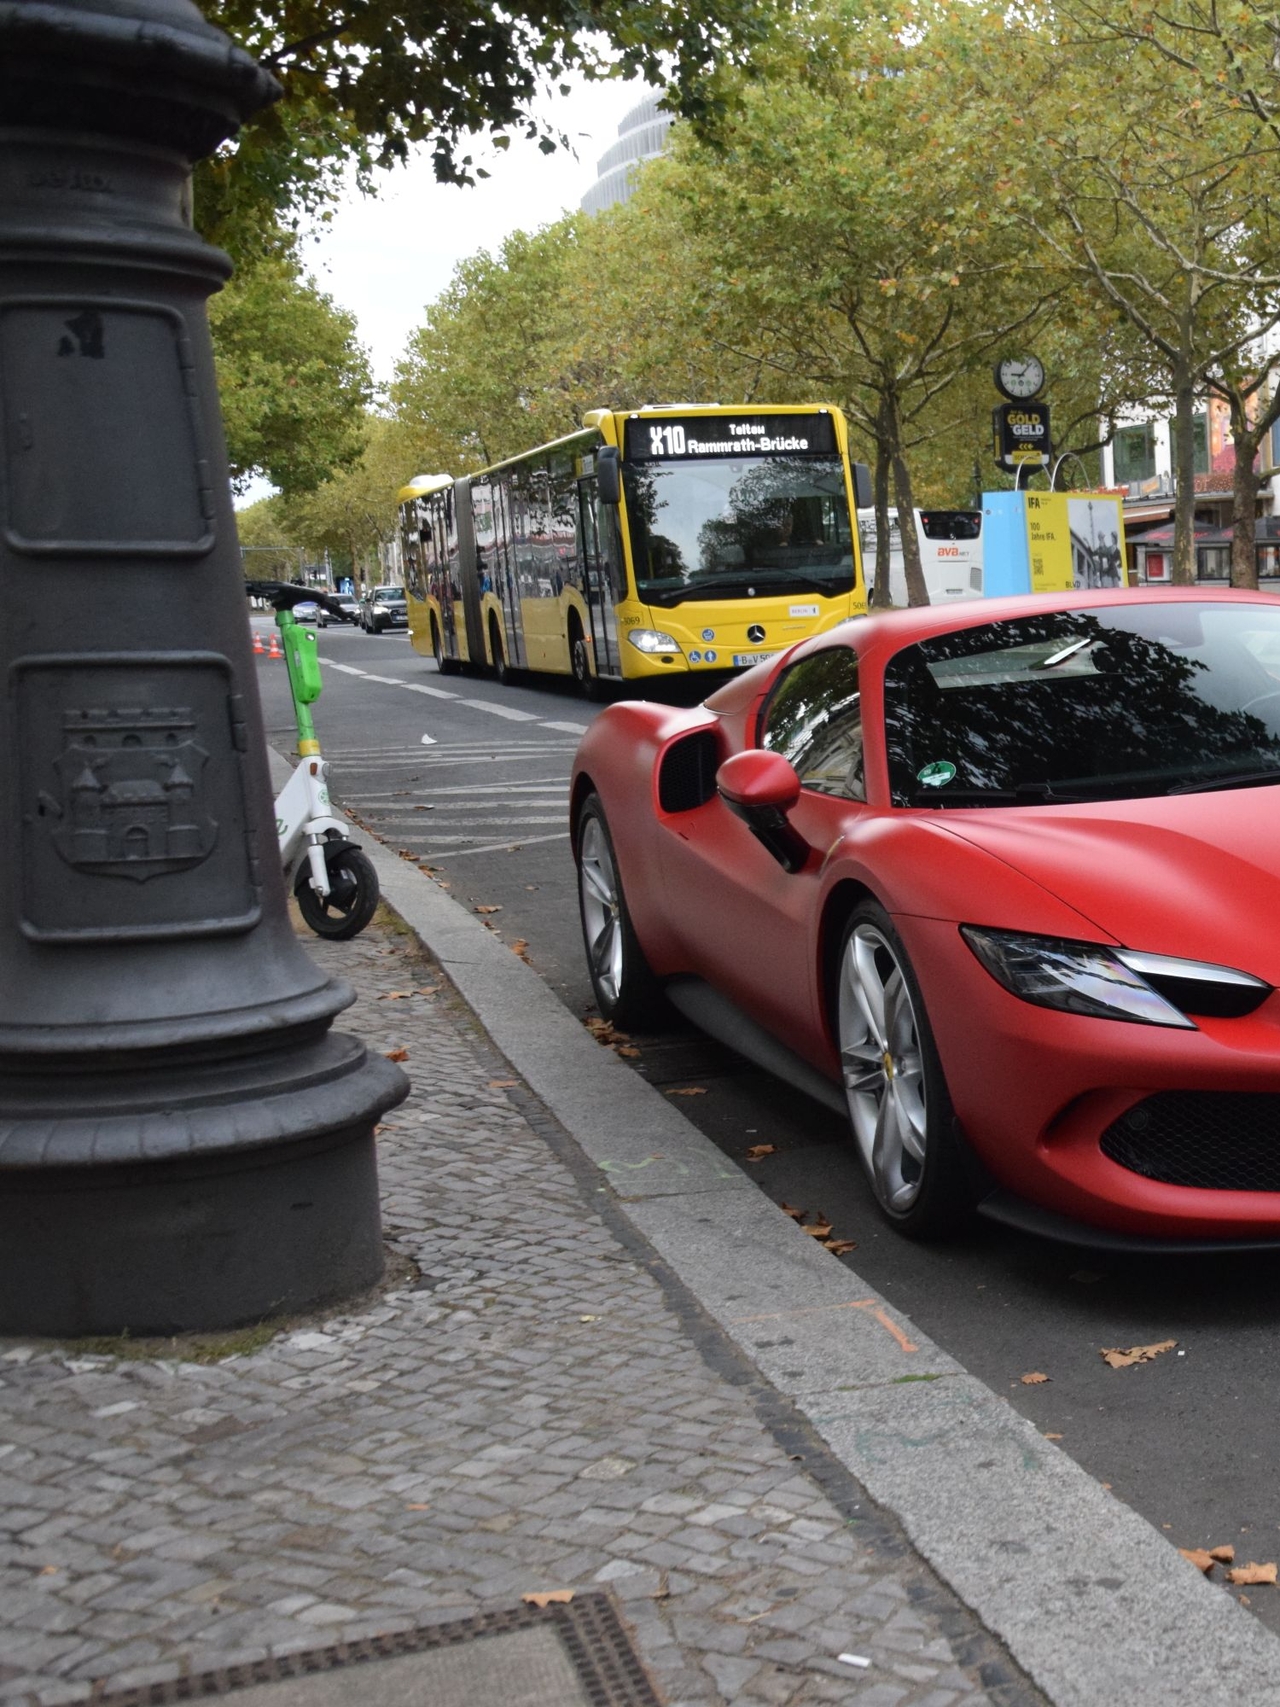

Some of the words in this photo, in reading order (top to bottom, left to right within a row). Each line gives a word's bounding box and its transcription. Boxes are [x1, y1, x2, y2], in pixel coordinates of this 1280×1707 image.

[1007, 414, 1040, 425] GOLD
[729, 424, 765, 436] Teltow
[1012, 424, 1044, 436] GELD
[650, 426, 686, 455] X10
[687, 436, 808, 453] Rammrath-Brücke
[1028, 497, 1040, 509] IFA
[1030, 522, 1040, 531] 100
[1065, 581, 1080, 589] BLVD
[741, 656, 748, 665] B
[753, 655, 759, 663] V
